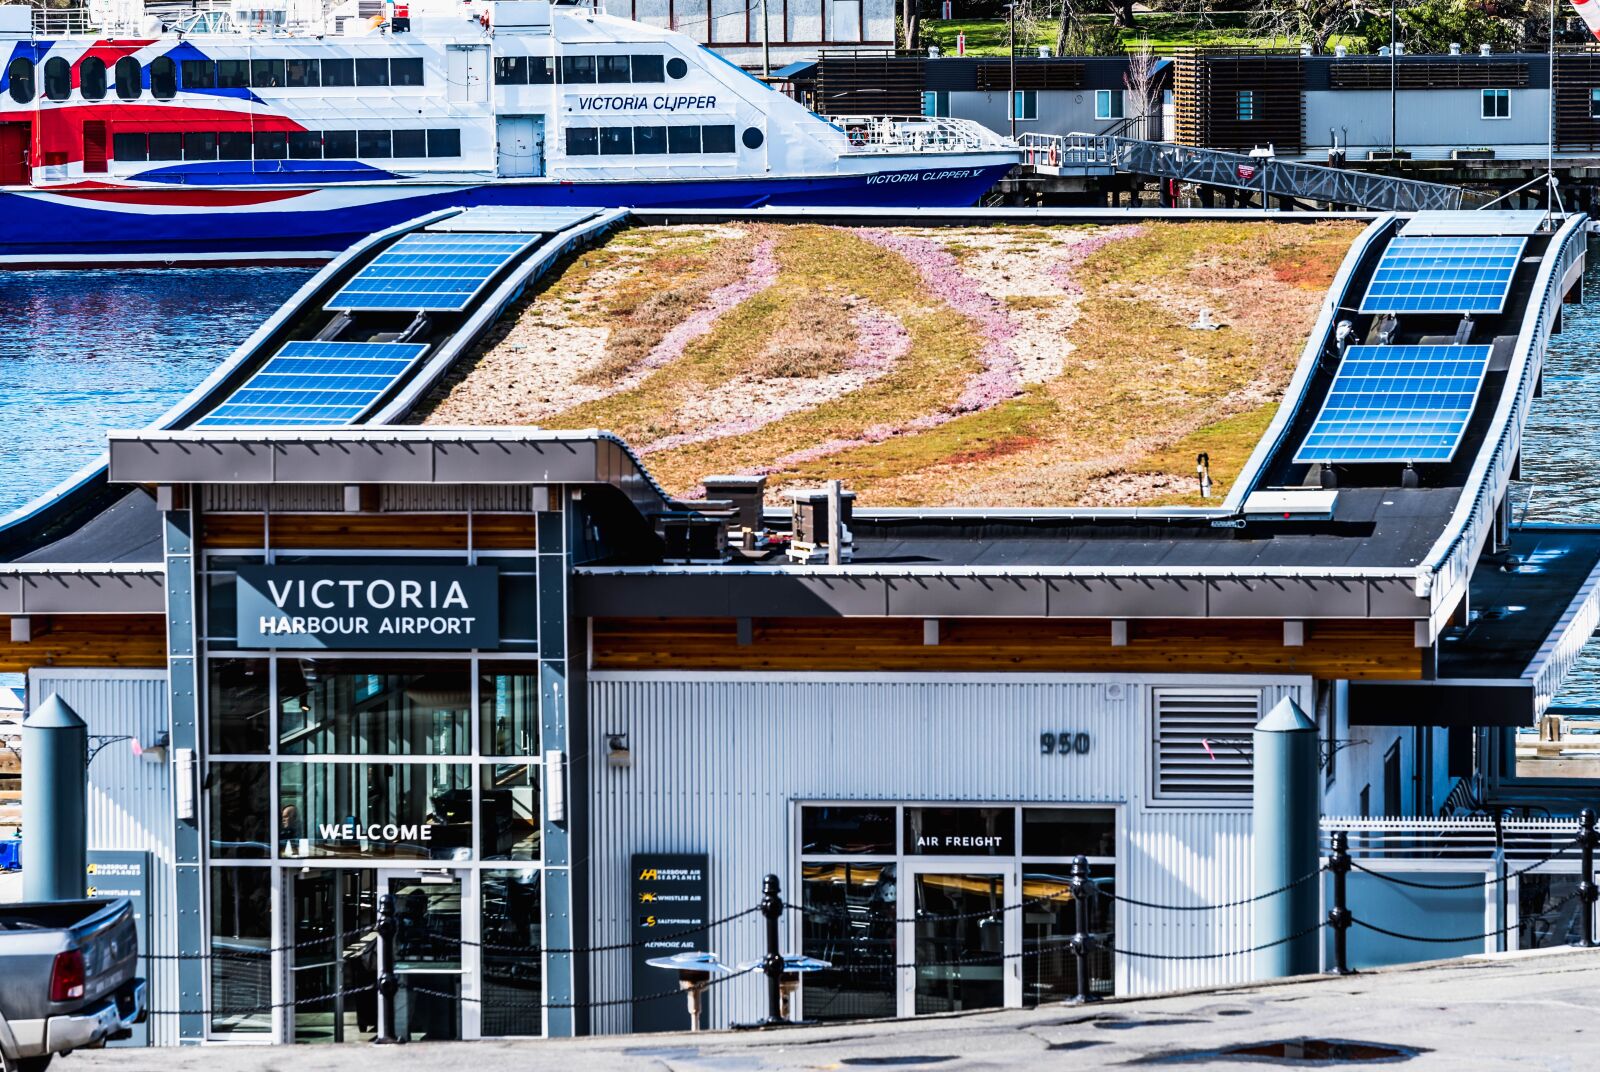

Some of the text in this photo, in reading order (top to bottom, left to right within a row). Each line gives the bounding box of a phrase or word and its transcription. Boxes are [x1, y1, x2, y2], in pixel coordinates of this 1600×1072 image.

[579, 96, 717, 110] VICTORIA CLIPPER
[866, 169, 986, 184] VICTORIA CLIPPER V
[267, 580, 469, 609] VICTORIA
[259, 616, 476, 635] HARBOUR AIRPORT
[1040, 732, 1090, 755] 950
[319, 823, 433, 841] WELCOME
[917, 836, 1002, 847] AIR FREIGHT
